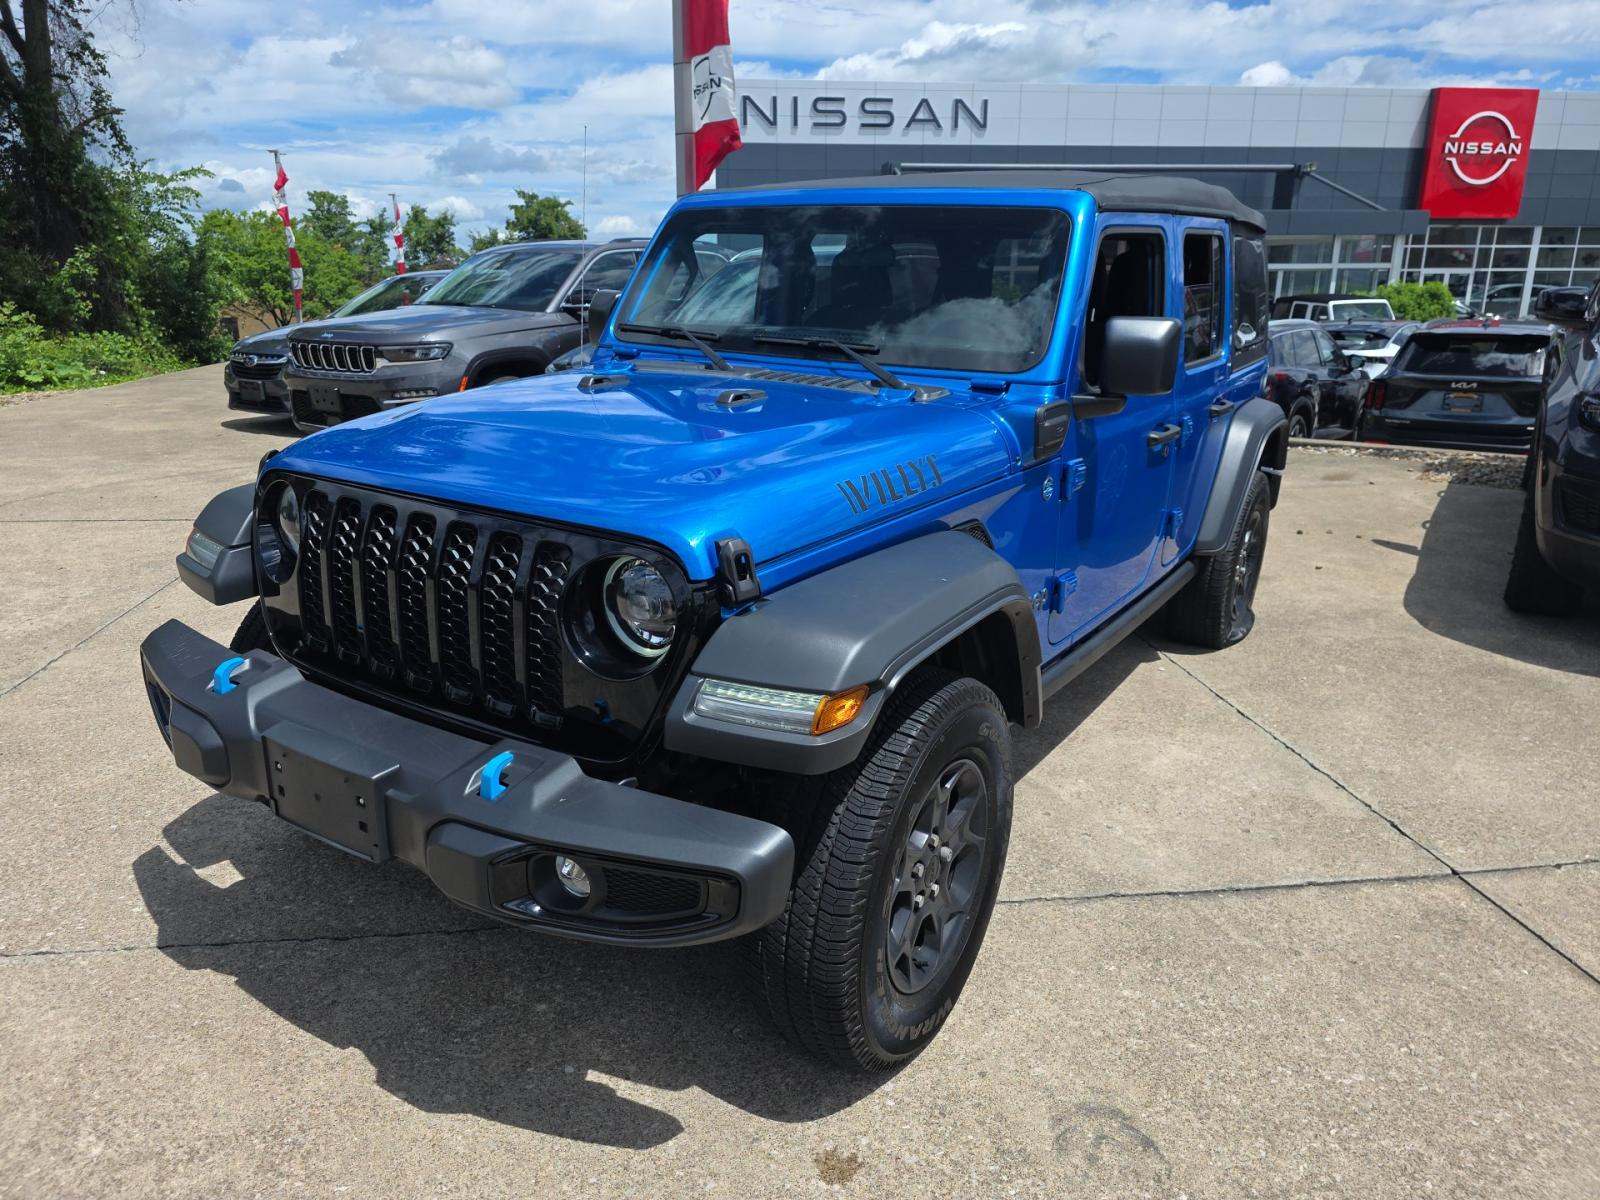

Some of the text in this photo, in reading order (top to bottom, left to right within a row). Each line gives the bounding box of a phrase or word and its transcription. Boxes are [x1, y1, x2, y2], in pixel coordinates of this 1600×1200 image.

[742, 95, 989, 129] NISSAN
[1444, 141, 1522, 155] NISSAN
[837, 455, 943, 514] WILLYS
